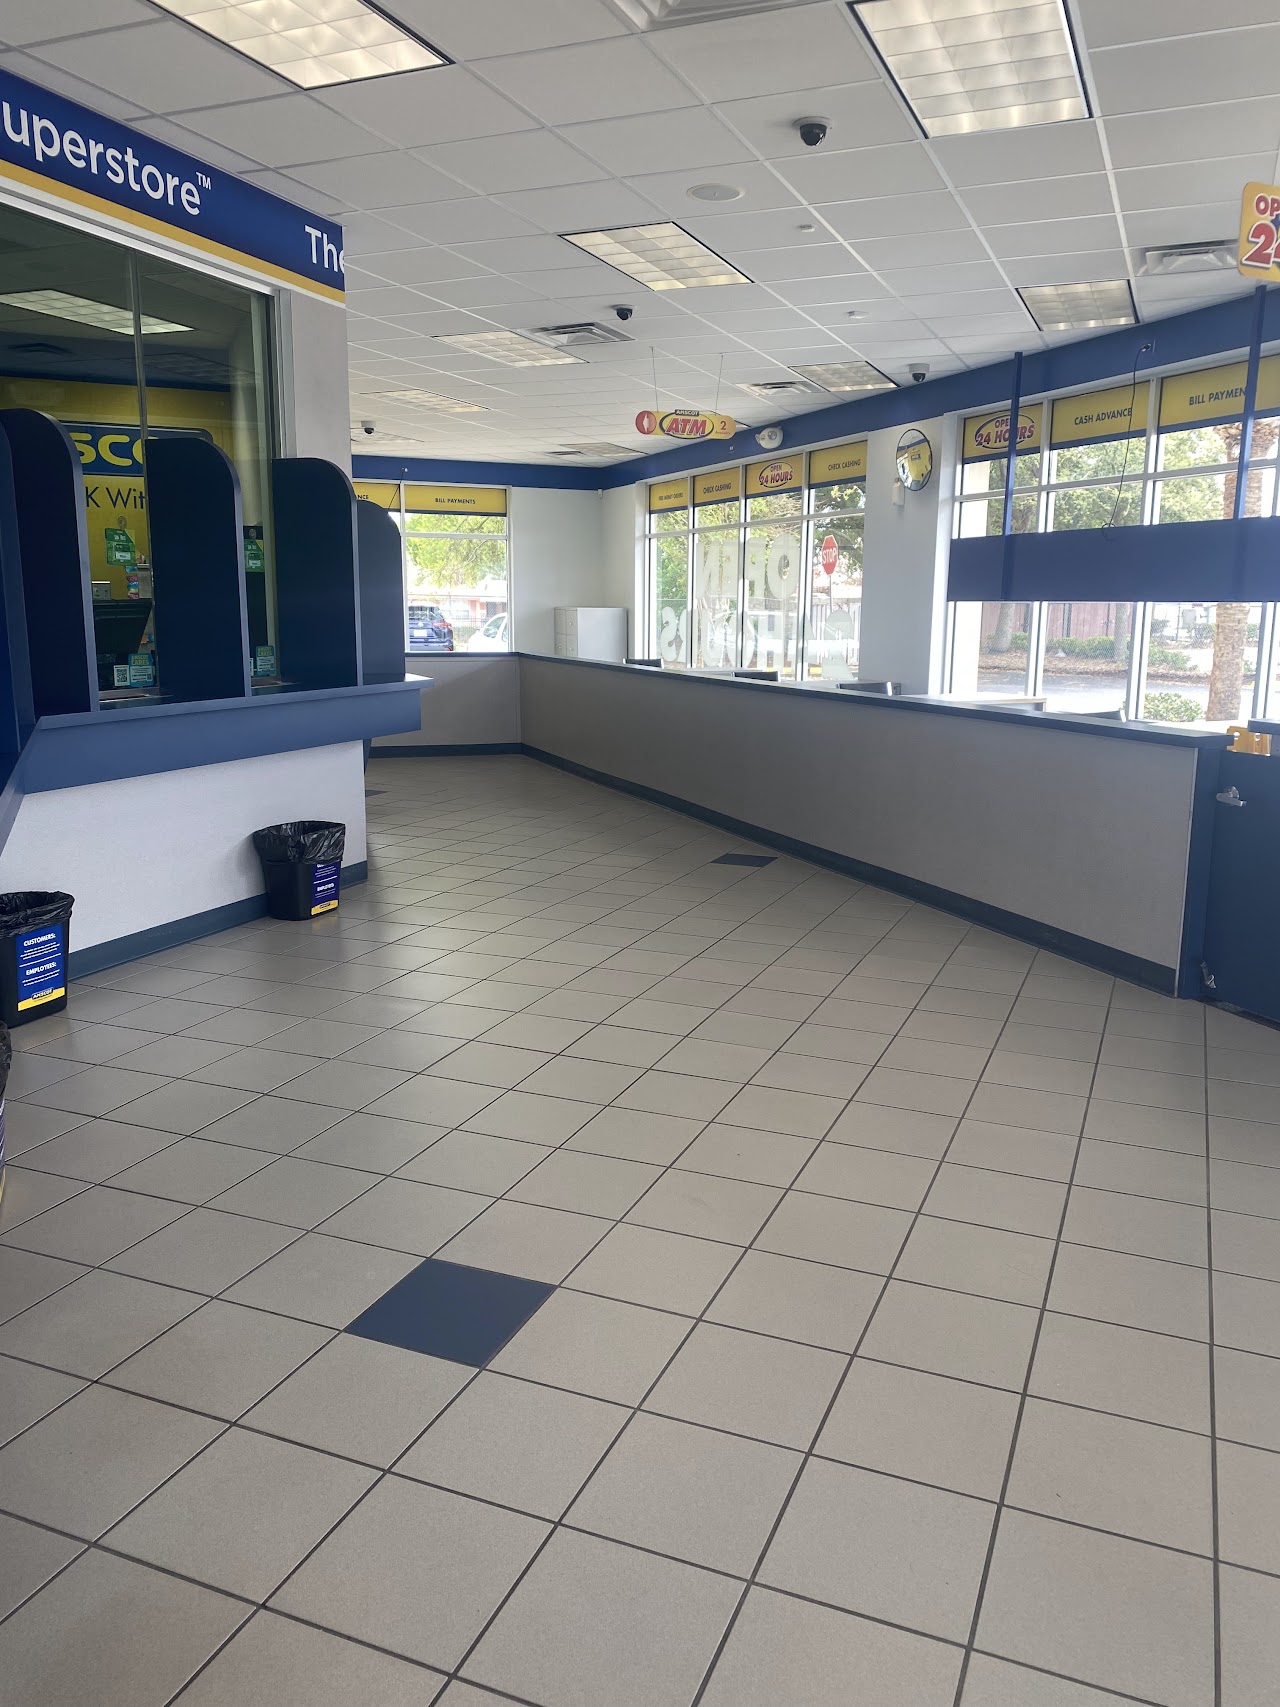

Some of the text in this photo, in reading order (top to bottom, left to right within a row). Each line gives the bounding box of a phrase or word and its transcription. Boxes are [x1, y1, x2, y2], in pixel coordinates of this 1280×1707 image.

[1188, 386, 1247, 406] BILL PAYMEN
[994, 418, 1010, 428] OPE
[1074, 407, 1132, 425] CASH ADVANCE
[664, 417, 707, 436] ATM
[719, 420, 727, 431] 2
[976, 424, 1035, 446] 24 HORS
[770, 463, 782, 472] OPEN
[827, 459, 861, 471] CHECK CASHING
[759, 469, 794, 486] 24 HOURS
[702, 482, 732, 494] CHECK CASHING
[105, 486, 146, 510] Wit
[822, 548, 837, 564] STOP
[23, 932, 57, 947] CUSTOMERS:
[25, 961, 57, 976] EMPLOYEES:
